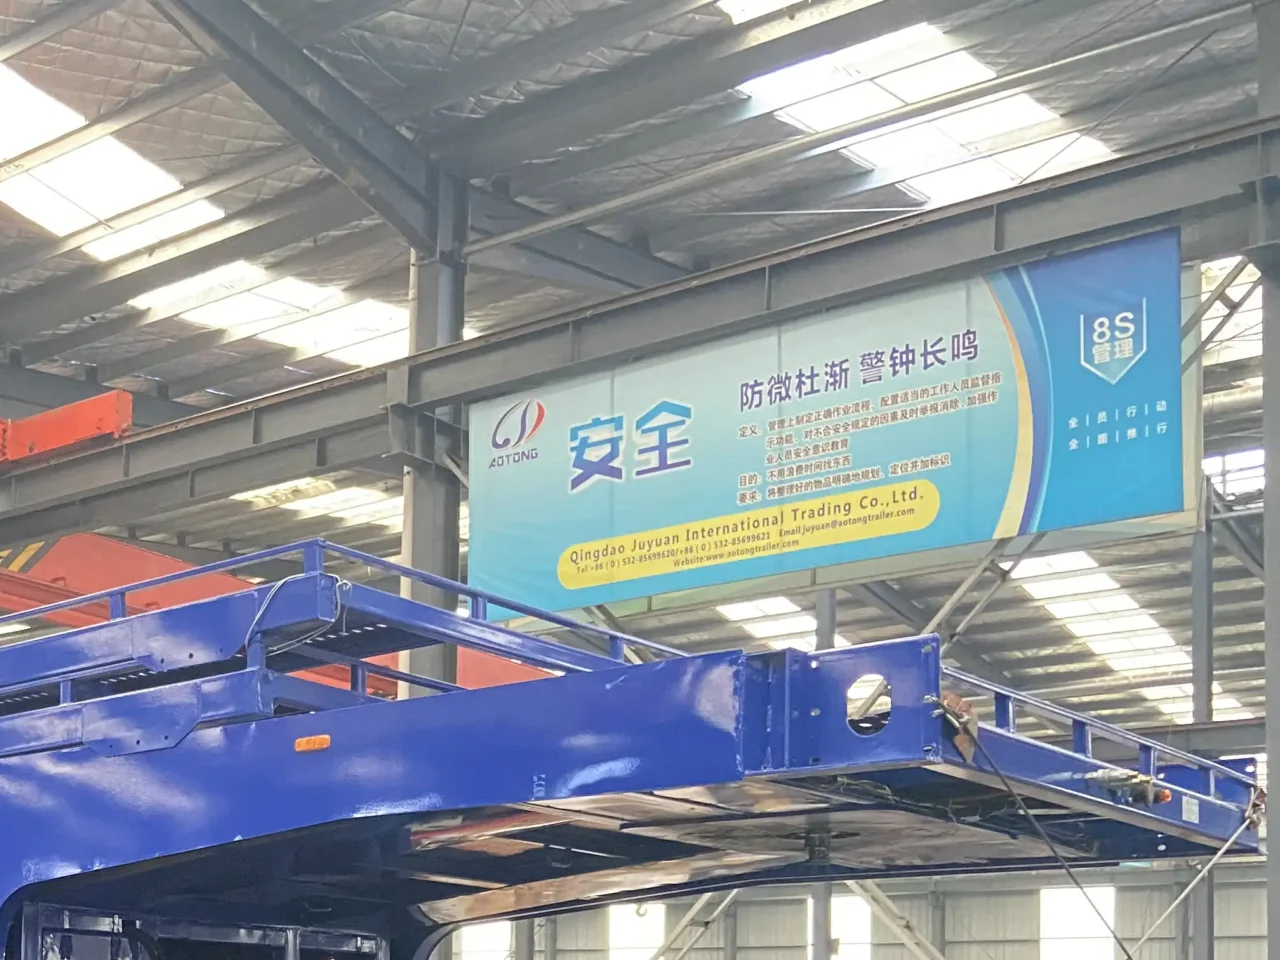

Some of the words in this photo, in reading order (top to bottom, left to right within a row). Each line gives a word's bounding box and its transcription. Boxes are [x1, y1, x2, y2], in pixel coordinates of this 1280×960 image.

[1092, 311, 1135, 343] 8S
[1092, 338, 1134, 364] 管理
[739, 358, 850, 412] 防微杜渐
[859, 329, 979, 385] 警钟长鸣
[488, 448, 538, 469] AOTONG
[569, 400, 692, 491] 安全
[570, 544, 625, 565] Qingdao
[631, 533, 680, 553] Juyuan
[686, 510, 784, 541] International
[791, 501, 852, 522] Trading
[859, 486, 924, 510] Co.,Ltd.
